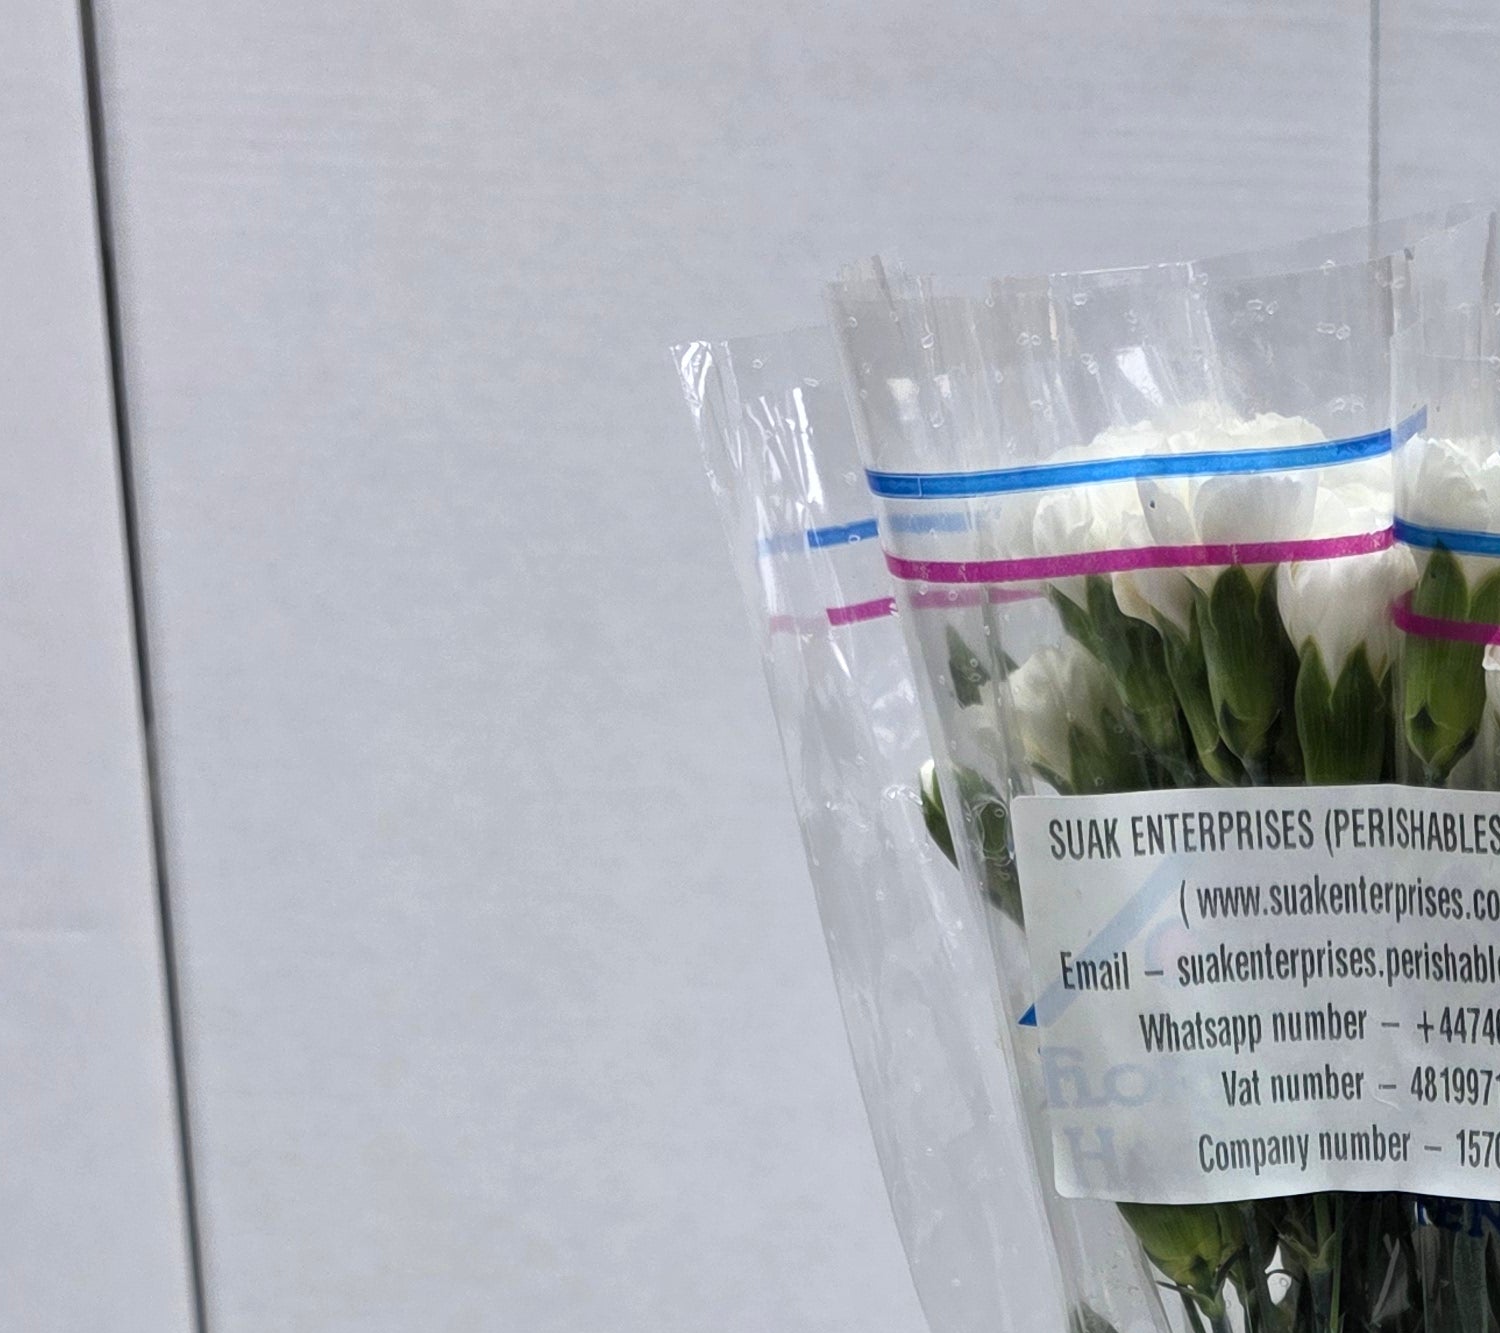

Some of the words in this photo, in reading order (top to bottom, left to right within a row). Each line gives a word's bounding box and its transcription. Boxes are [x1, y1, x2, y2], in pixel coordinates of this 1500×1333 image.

[1048, 820, 1121, 860] SUAK
[1131, 808, 1315, 856] ENTERPRISES
[1059, 951, 1130, 991] Email
[1138, 1011, 1262, 1055] Whatsapp
[1272, 1004, 1368, 1042] number
[1221, 1069, 1261, 1107] Vat
[1270, 1065, 1364, 1103] number
[1198, 1133, 1310, 1176] Company
[1318, 1124, 1411, 1162] number
